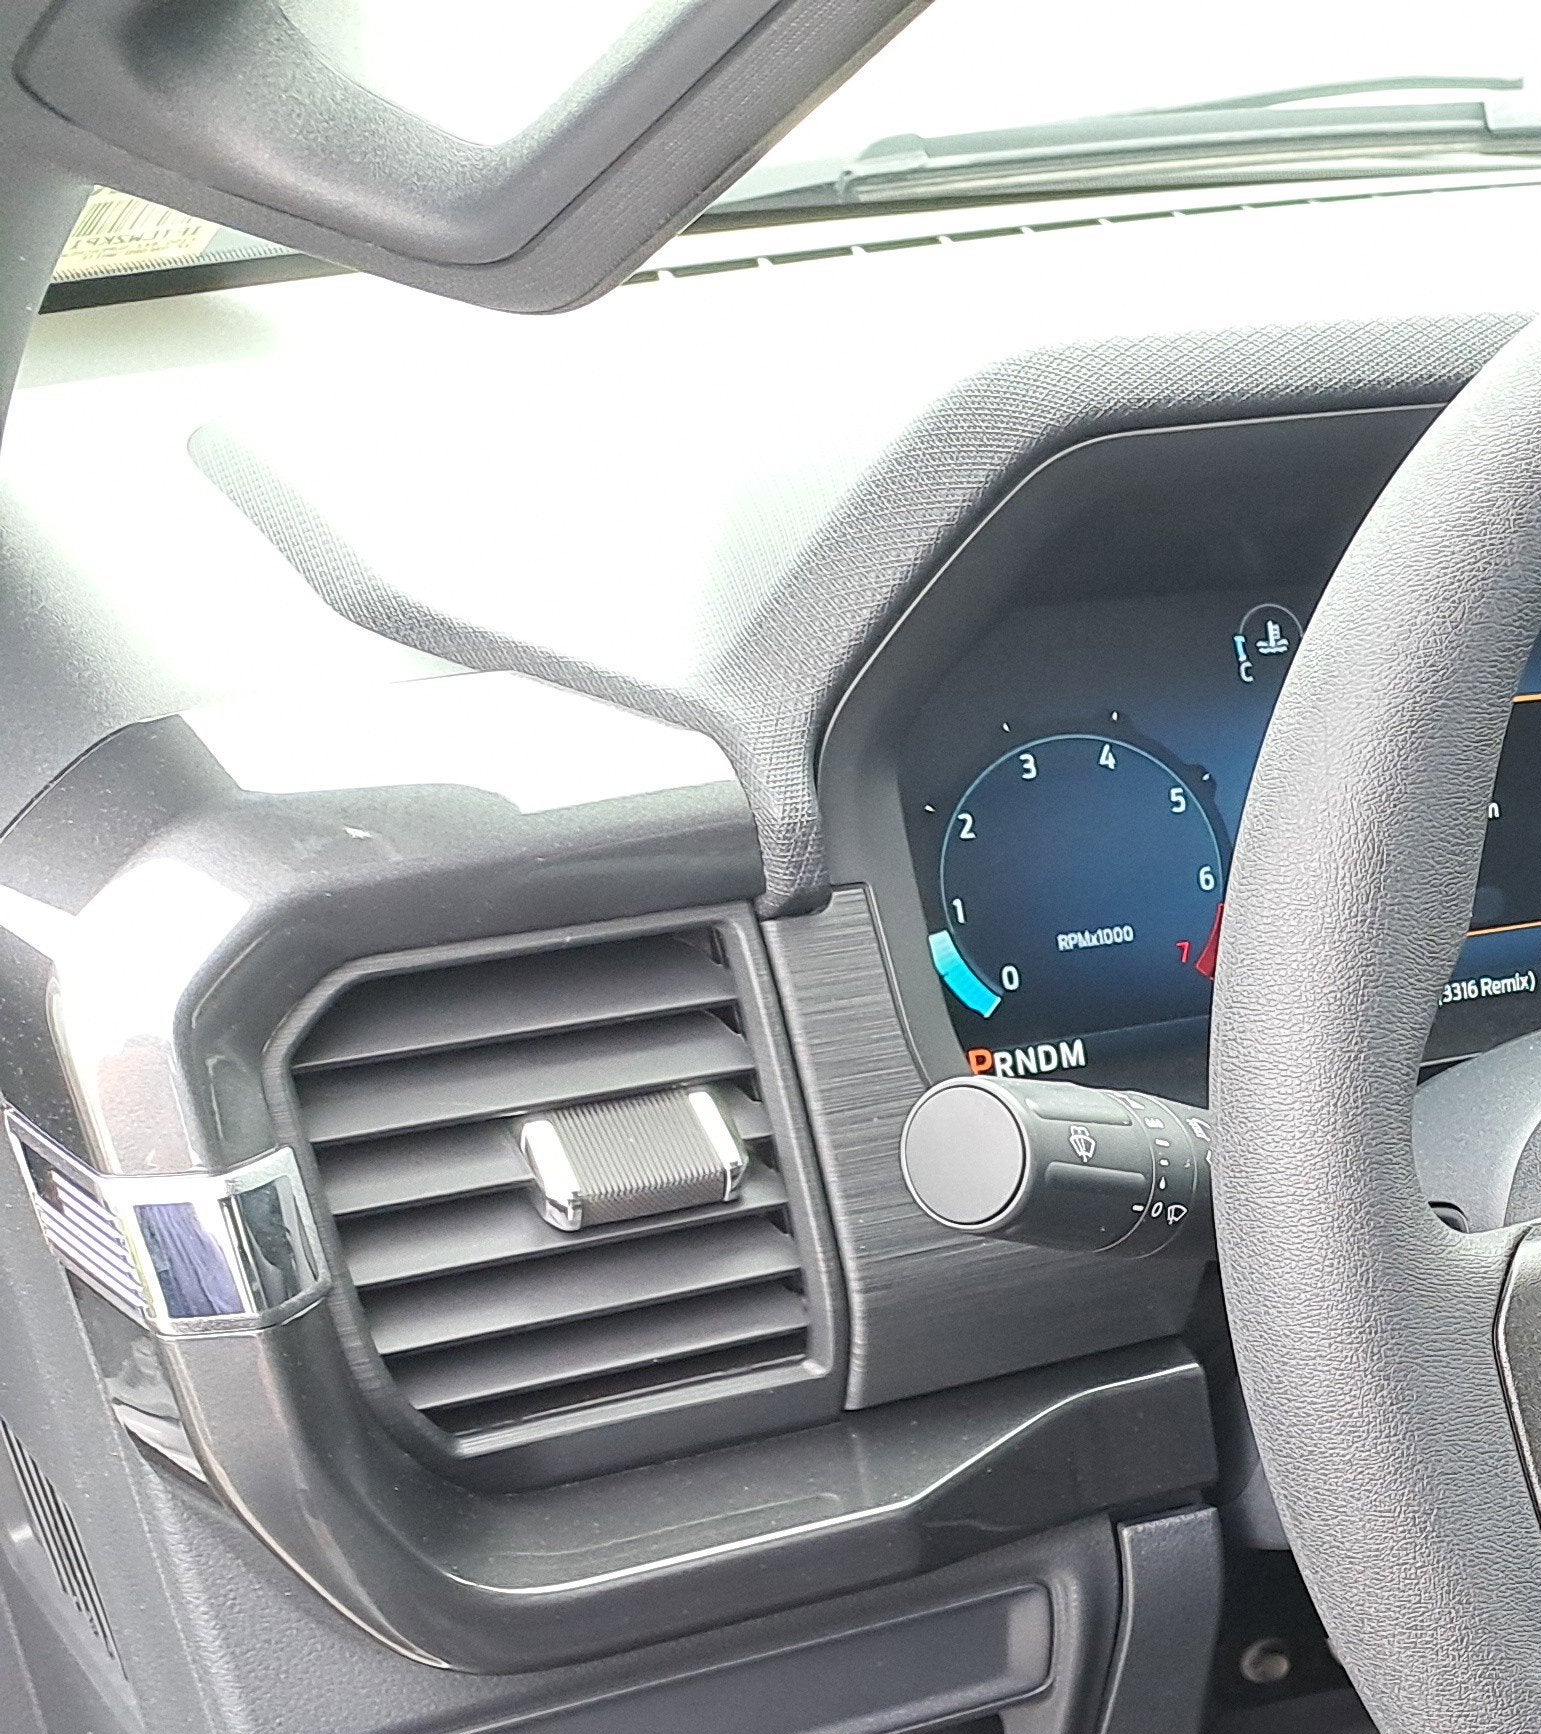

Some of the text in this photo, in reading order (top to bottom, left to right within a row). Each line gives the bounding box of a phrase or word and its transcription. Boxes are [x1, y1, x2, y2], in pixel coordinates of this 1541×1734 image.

[1239, 661, 1255, 683] C
[1020, 754, 1038, 781] 3
[1099, 744, 1116, 770] 4
[1169, 787, 1187, 814] 5
[958, 813, 977, 841] 2
[1198, 866, 1215, 891] 6
[952, 898, 966, 925] 1
[1056, 925, 1135, 953] RPMx1000
[1175, 941, 1190, 964] 7
[1001, 965, 1020, 992] 0
[1479, 970, 1536, 998] Remix)
